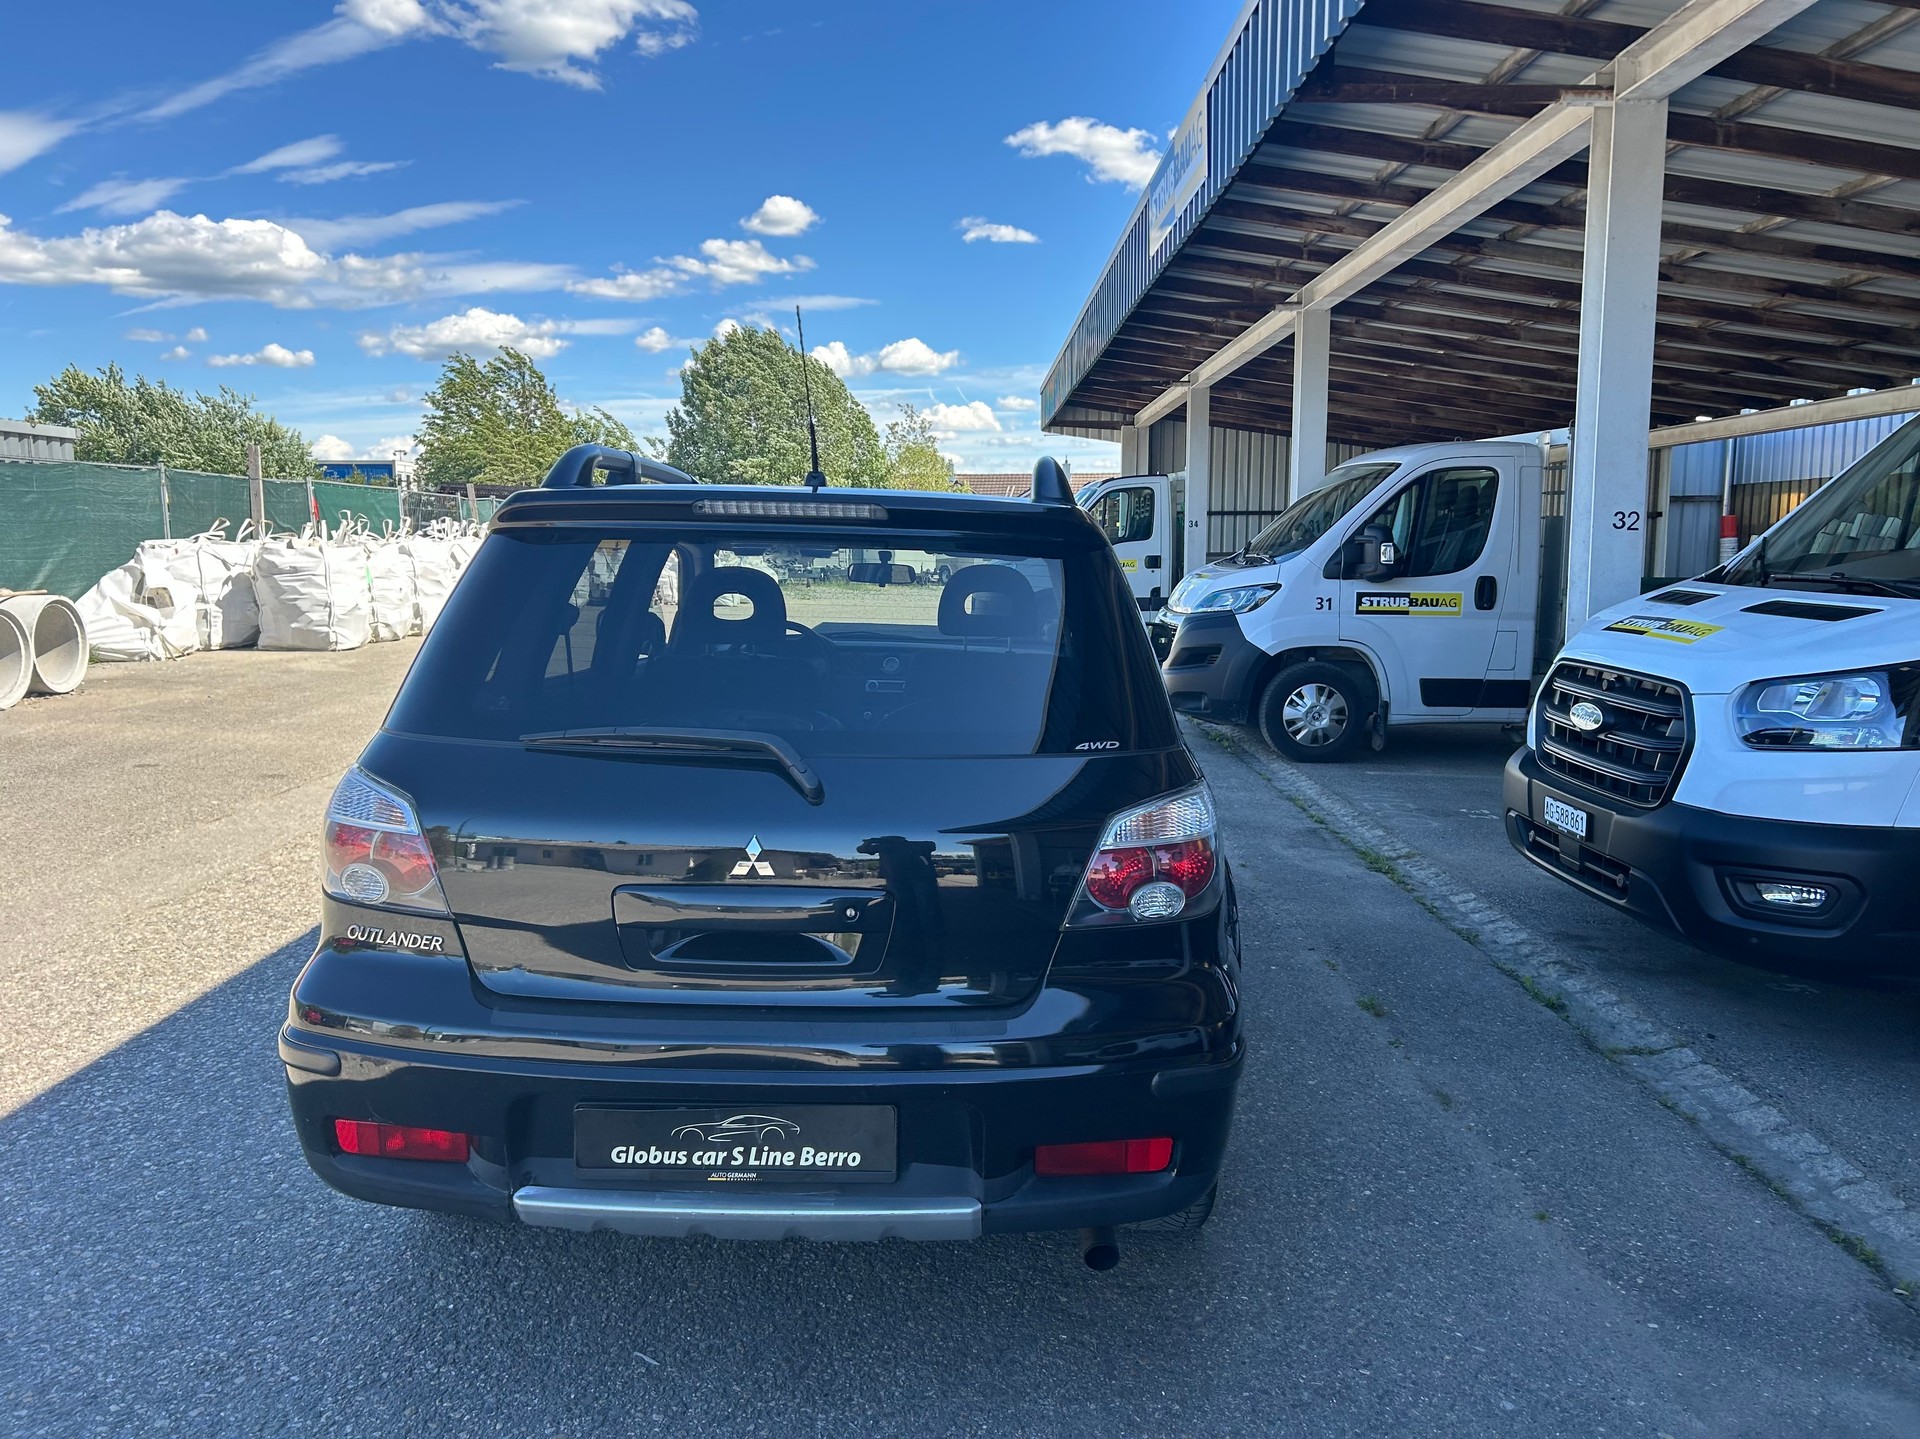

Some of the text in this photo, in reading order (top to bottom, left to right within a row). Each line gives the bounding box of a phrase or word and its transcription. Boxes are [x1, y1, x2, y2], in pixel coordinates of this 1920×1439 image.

[1188, 520, 1199, 528] 34
[1612, 511, 1640, 531] 32
[1315, 597, 1333, 611] 31
[1075, 741, 1120, 751] 4WD
[347, 924, 444, 952] OUTLANDER
[610, 1146, 862, 1168] Globus car S Line Berro
